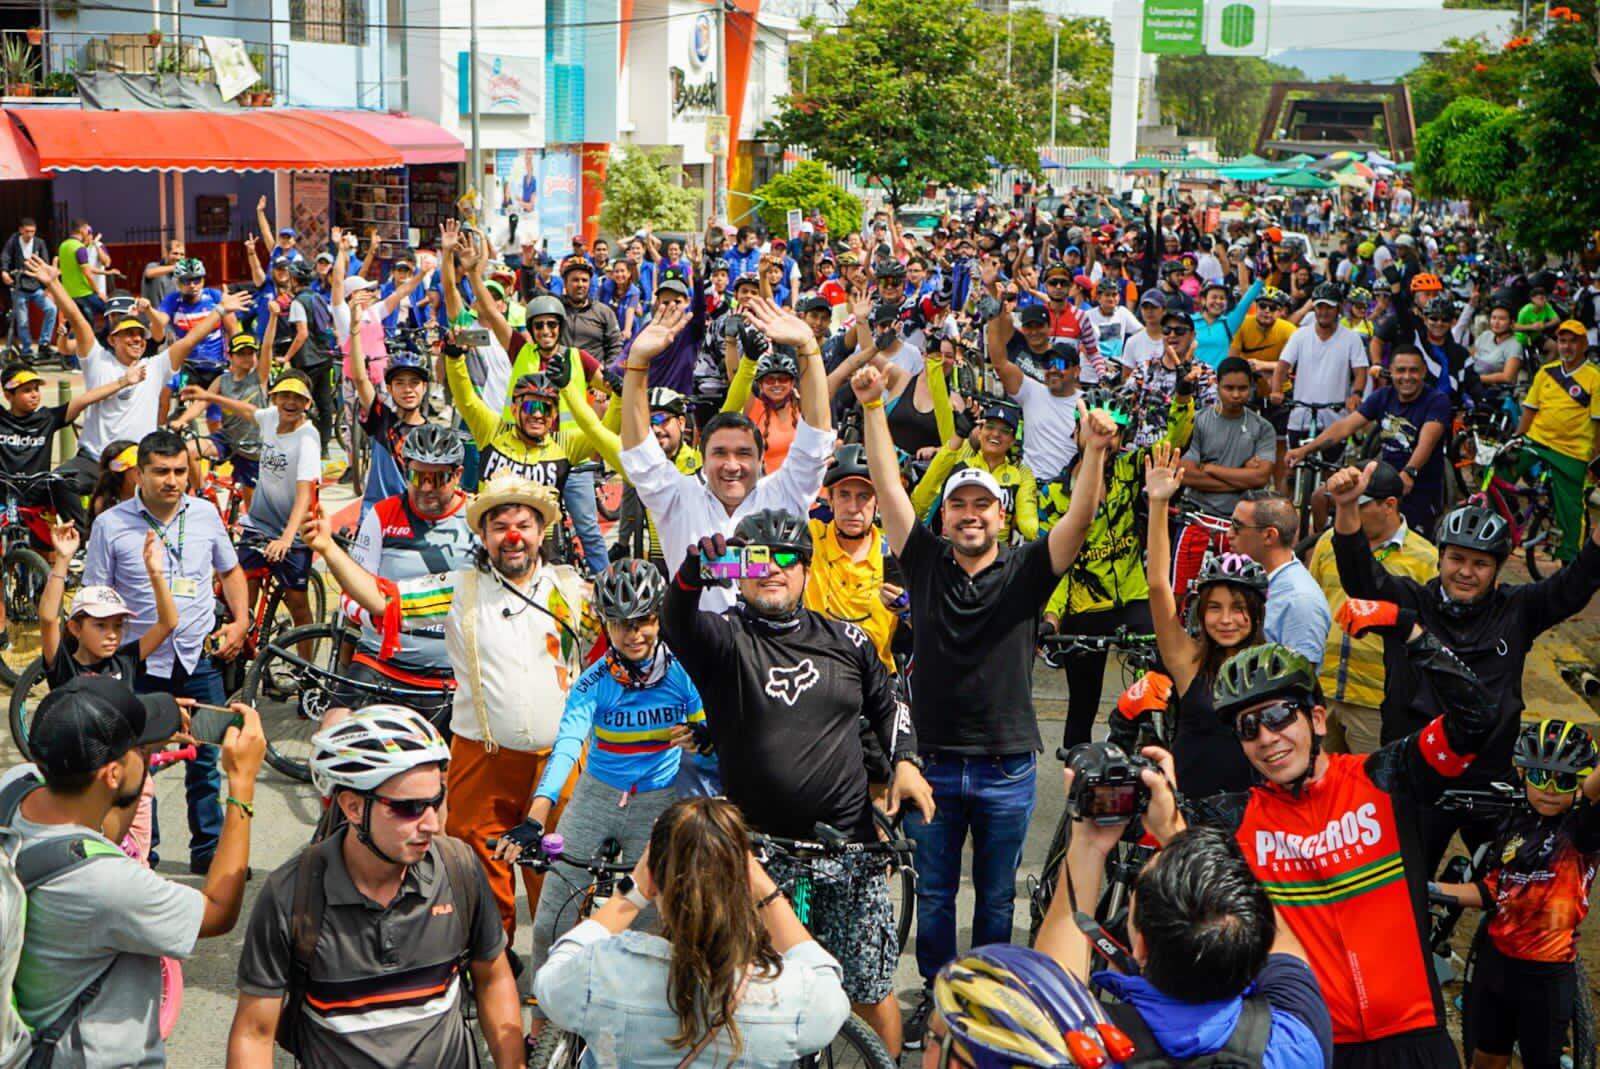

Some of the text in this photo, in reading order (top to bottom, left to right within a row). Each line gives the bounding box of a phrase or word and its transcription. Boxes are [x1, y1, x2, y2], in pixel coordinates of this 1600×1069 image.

[0, 435, 46, 447] adidas
[431, 903, 454, 917] FILA
[1096, 938, 1118, 956] EOS
